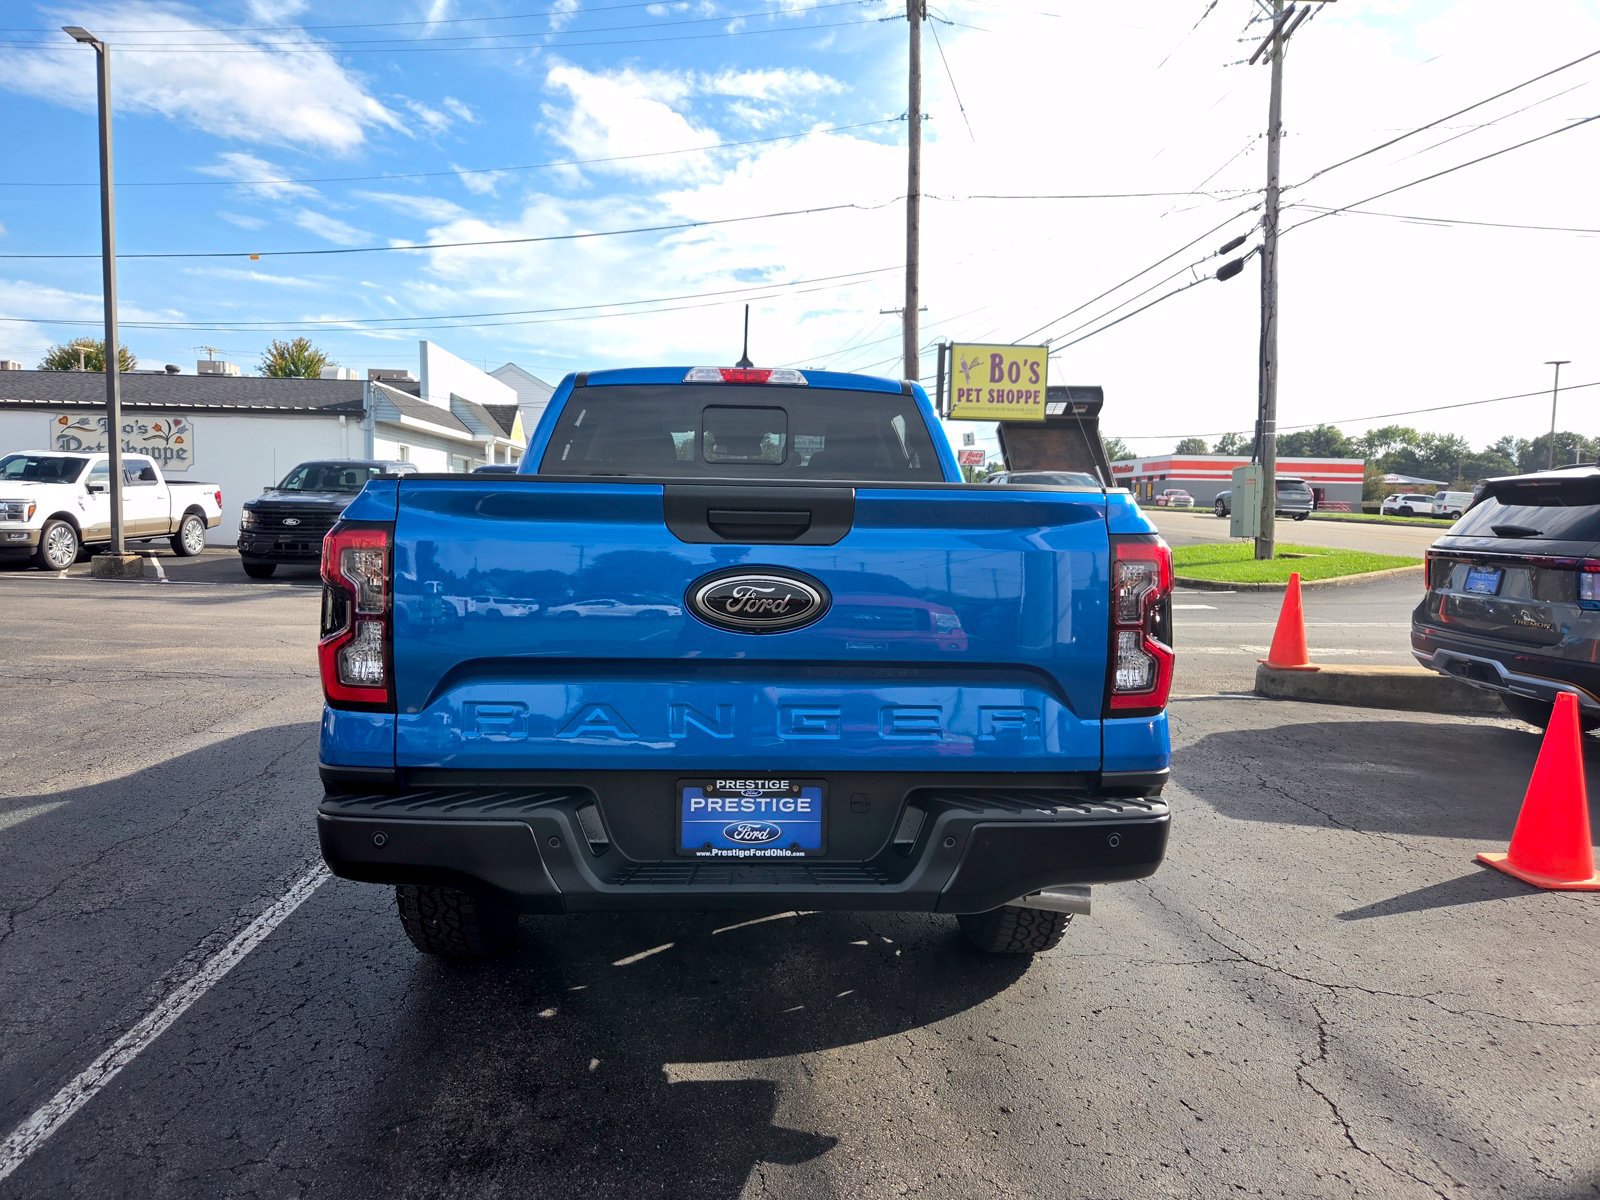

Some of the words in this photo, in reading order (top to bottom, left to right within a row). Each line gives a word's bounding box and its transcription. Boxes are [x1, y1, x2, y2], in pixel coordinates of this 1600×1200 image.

[989, 351, 1041, 385] Bo's
[957, 388, 983, 404] PET
[987, 388, 1041, 405] SHOPPE
[121, 438, 188, 466] hoppe
[725, 585, 792, 613] Ford
[1514, 619, 1552, 629] TREMOR
[462, 700, 1042, 741] RANGER
[716, 780, 790, 789] PRESTIGE
[690, 798, 812, 812] PRESTIGE
[733, 823, 770, 840] Ford
[696, 848, 805, 858] www.PrestigeFordOhio.com
